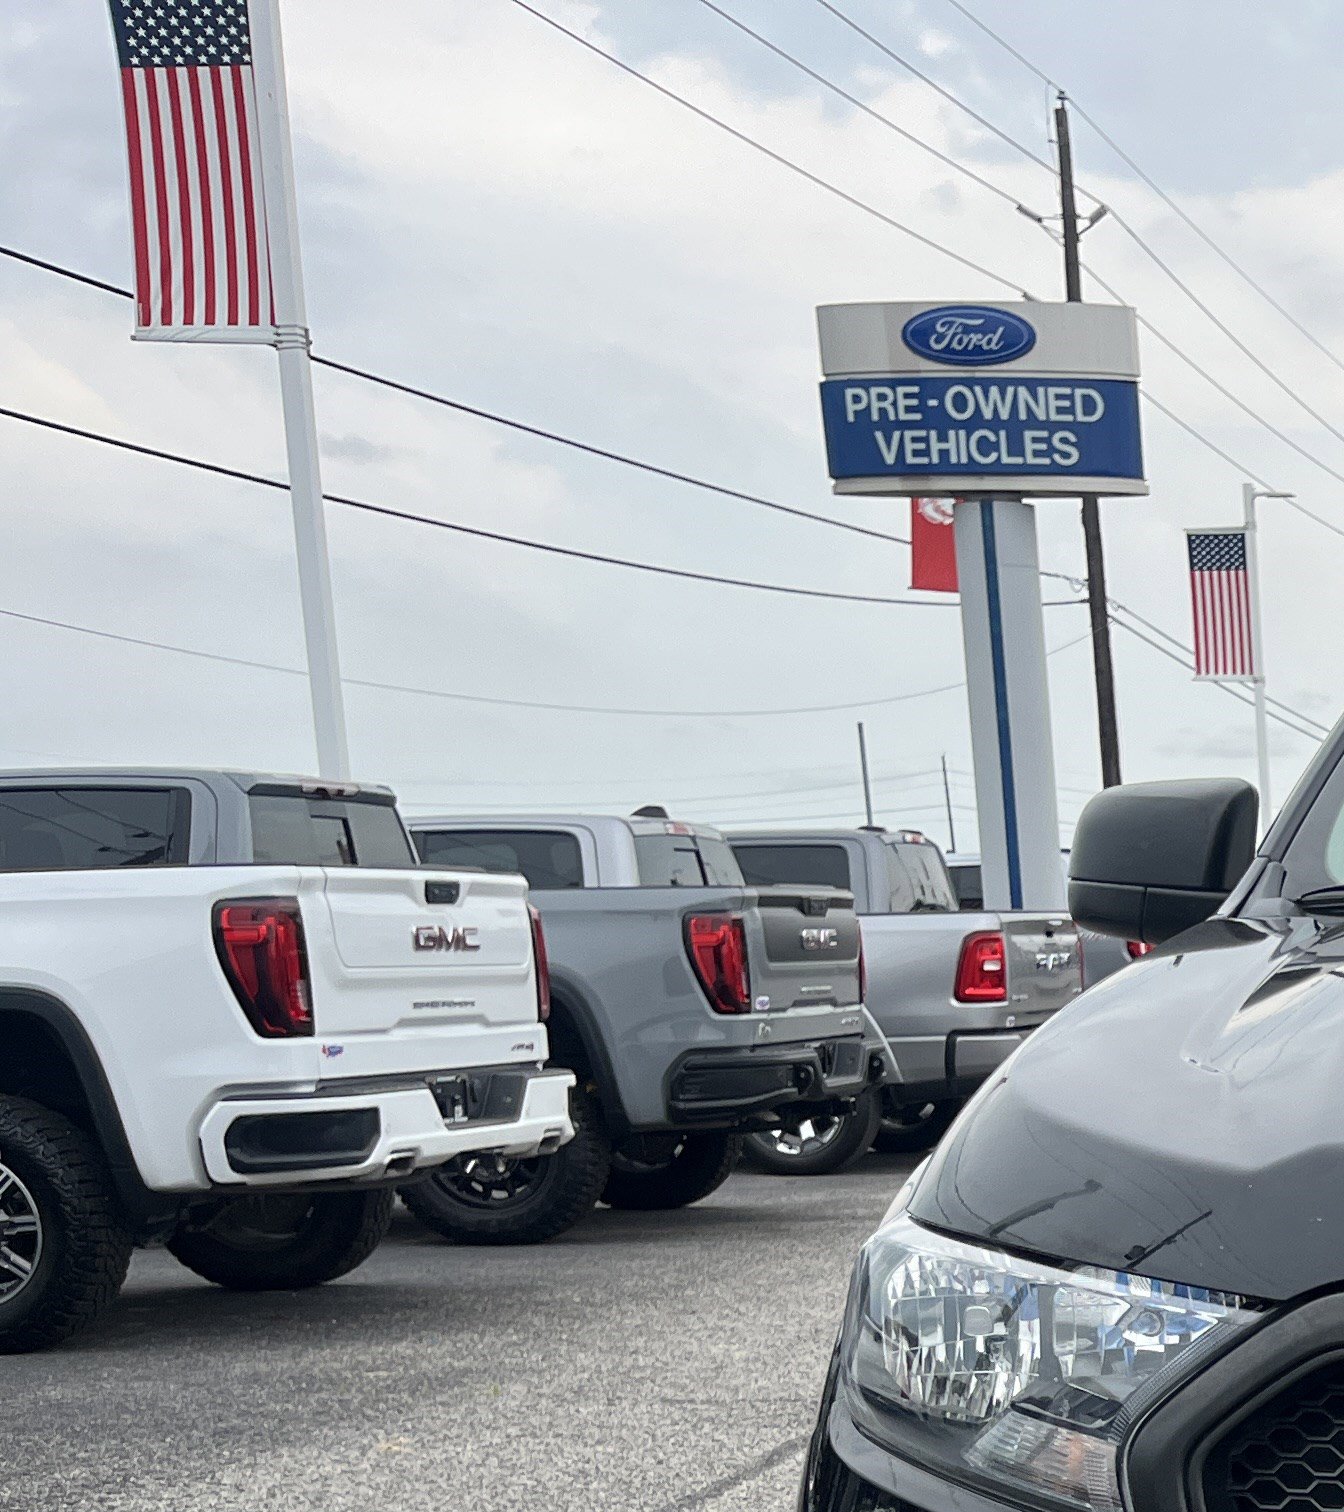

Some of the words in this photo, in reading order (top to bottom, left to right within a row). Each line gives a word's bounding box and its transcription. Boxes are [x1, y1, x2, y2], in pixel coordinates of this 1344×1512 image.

[928, 316, 1005, 352] Ford
[844, 384, 1105, 423] PRE-OWNED
[873, 429, 1081, 467] VEHICLES
[411, 924, 481, 951] GMC
